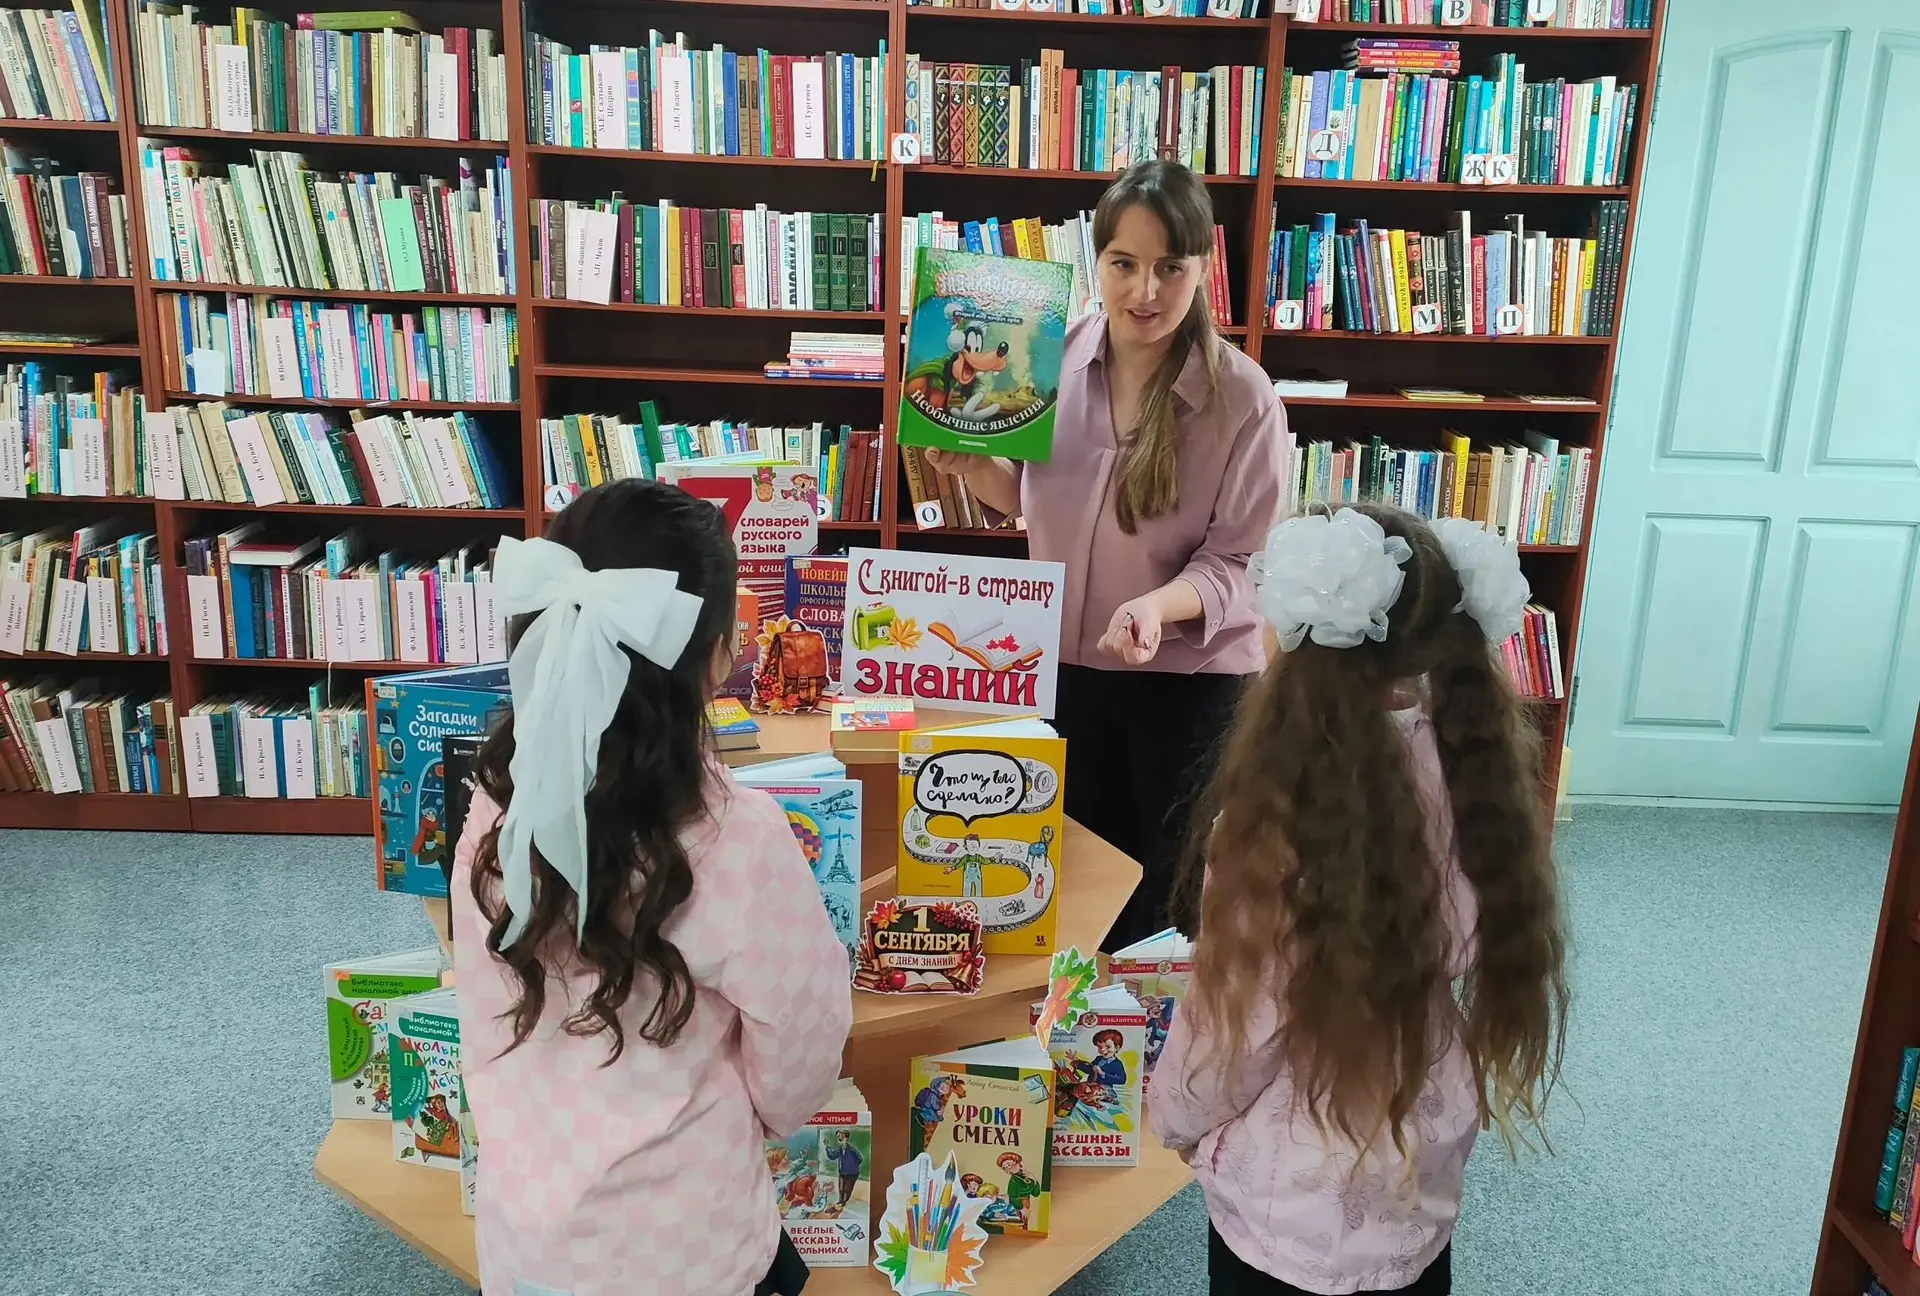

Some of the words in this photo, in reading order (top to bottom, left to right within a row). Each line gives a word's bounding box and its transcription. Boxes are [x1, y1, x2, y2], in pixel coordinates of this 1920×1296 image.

[1450, 0, 1465, 19] В
[805, 84, 813, 118] Тургенев
[438, 110, 444, 119] 85
[899, 140, 914, 157] К
[1316, 133, 1332, 155] Д
[1466, 160, 1485, 177] Ж
[1492, 160, 1507, 178] К
[85, 185, 96, 224] УЛЬЯНОВЫХ
[92, 226, 100, 247] СЕМЬЯ
[229, 219, 240, 250] ЭРМИТАЖ
[400, 227, 408, 249] Музыка
[179, 239, 192, 280] БОЛЬШЯ
[594, 238, 603, 260] Чехов
[1280, 307, 1294, 324] Л
[1418, 308, 1437, 326] М
[1503, 310, 1516, 327] П
[274, 335, 285, 373] Психология
[910, 389, 987, 432] Необычные
[989, 398, 1046, 431] явления
[150, 434, 159, 462] Андреев
[164, 434, 173, 464] Аксаков
[246, 441, 260, 464] Бунин
[369, 442, 382, 466] Герцен
[433, 437, 449, 470] Гончаров
[11, 445, 20, 492] Экономические
[552, 490, 564, 504] А
[740, 515, 809, 529] словарей
[922, 510, 937, 525] О
[740, 530, 802, 543] русского
[740, 543, 786, 553] языка
[858, 558, 884, 596] С
[977, 575, 1054, 608] страну
[336, 596, 344, 631] Грибоедов
[358, 598, 366, 626] Горький
[407, 591, 416, 633] Достоевский
[457, 596, 465, 634] Жуковский
[415, 704, 477, 726] Загадки
[194, 732, 203, 767] Короленко
[295, 739, 304, 764] Куприн
[930, 764, 968, 788] Что
[970, 772, 991, 792] из
[926, 786, 1016, 806] сделано?
[912, 906, 930, 932] 1
[874, 930, 971, 951] СЕНТЯБРЯ
[888, 956, 894, 965] С
[895, 955, 918, 966] ДНЁМ
[920, 954, 956, 966] ЗНАНИЙ!
[352, 978, 404, 988] Библиотека
[352, 986, 399, 996] начальной
[408, 1024, 453, 1037] начальной
[1102, 1016, 1144, 1024] БИБЛИОТЕКА
[952, 1104, 1022, 1127] УРОКИ
[952, 1125, 1020, 1147] СМЕХА
[1053, 1133, 1122, 1145] МЕШНЫЕ
[1052, 1145, 1132, 1158] АССКАЗЫ
[790, 1226, 834, 1235] ВЕСЁЛЫЕ
[791, 1236, 840, 1245] АССКАЗЫ
